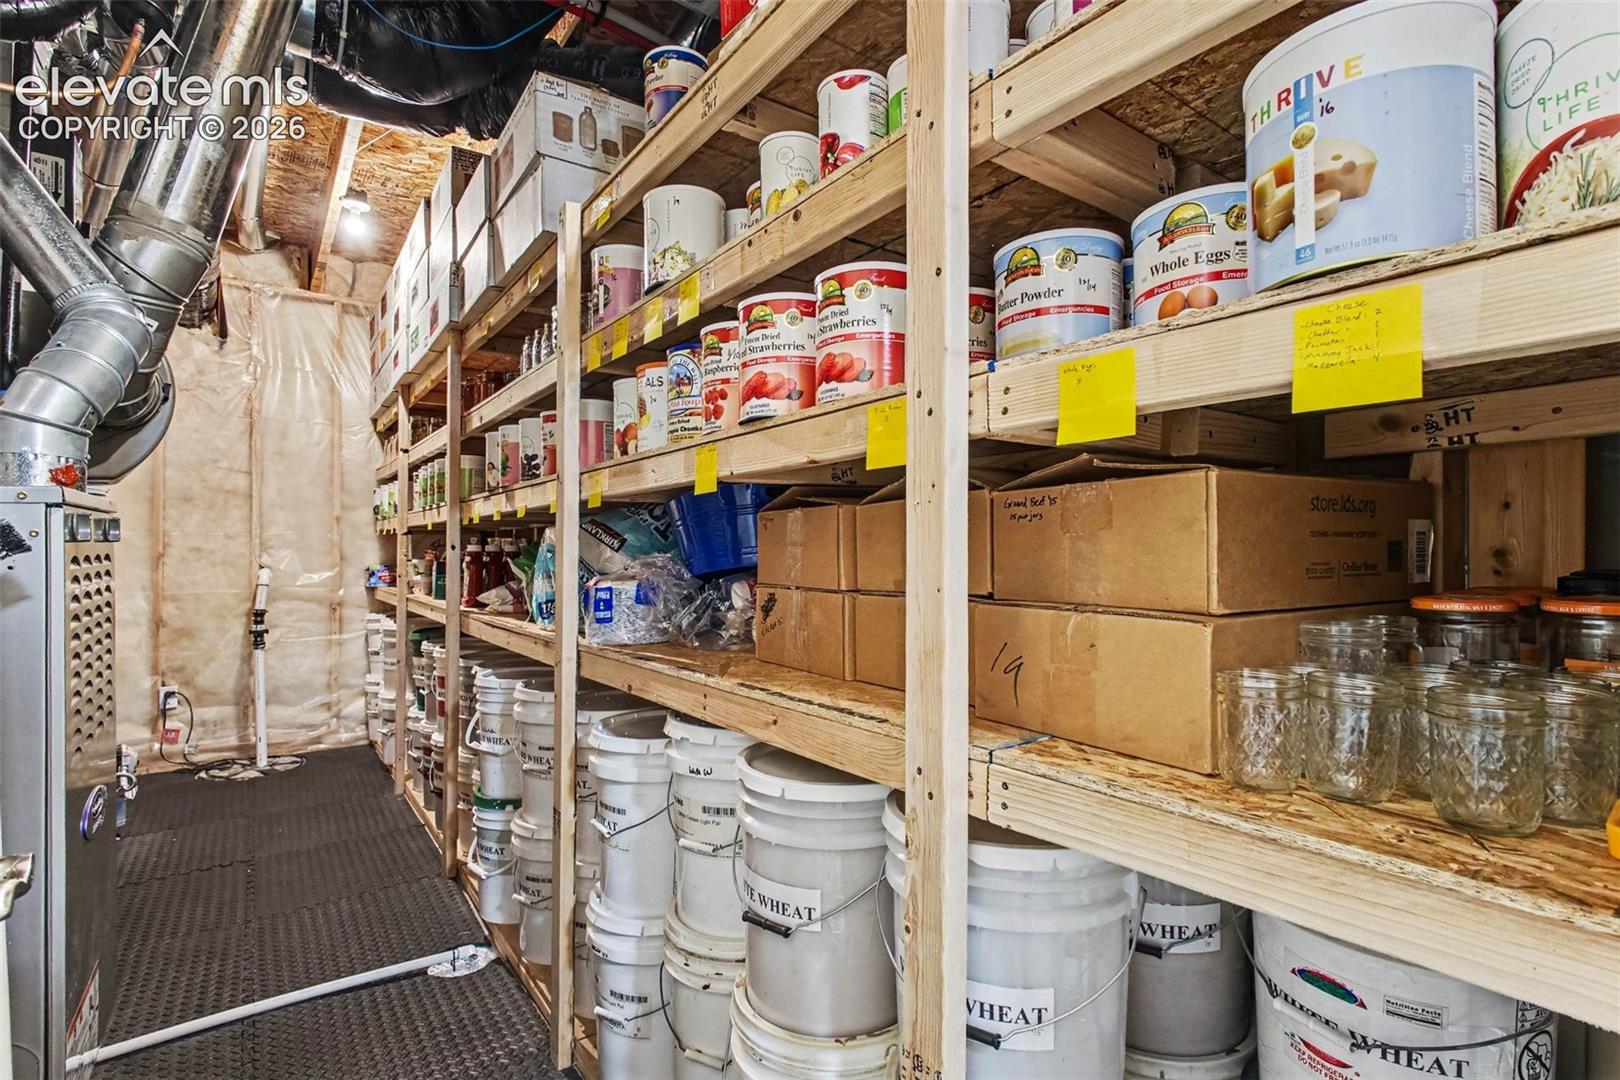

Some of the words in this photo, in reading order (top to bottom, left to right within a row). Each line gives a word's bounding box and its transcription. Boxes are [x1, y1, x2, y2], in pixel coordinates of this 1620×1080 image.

[1250, 54, 1363, 134] THRIVE
[1543, 95, 1601, 132] LIFE
[1149, 256, 1190, 279] Whole
[1194, 249, 1231, 266] Eggs
[1020, 287, 1064, 304] Powder
[830, 307, 849, 320] Dried
[819, 315, 877, 336] Strawberries
[762, 332, 781, 341] Dried
[748, 340, 806, 356] Strawberries
[1310, 493, 1377, 519] store.lds.org
[486, 737, 514, 747] WHEA
[527, 753, 554, 766] WHEA
[757, 892, 817, 922] WHEAT
[1139, 921, 1218, 941] WHEAT
[1385, 998, 1420, 1013] Nutrition
[1421, 1007, 1443, 1018] Facts
[1290, 1041, 1307, 1057] KEEP
[1307, 1053, 1353, 1080] REFRIGERA
[1347, 1028, 1471, 1079] WHEAT
[1308, 1061, 1323, 1076] NOT
